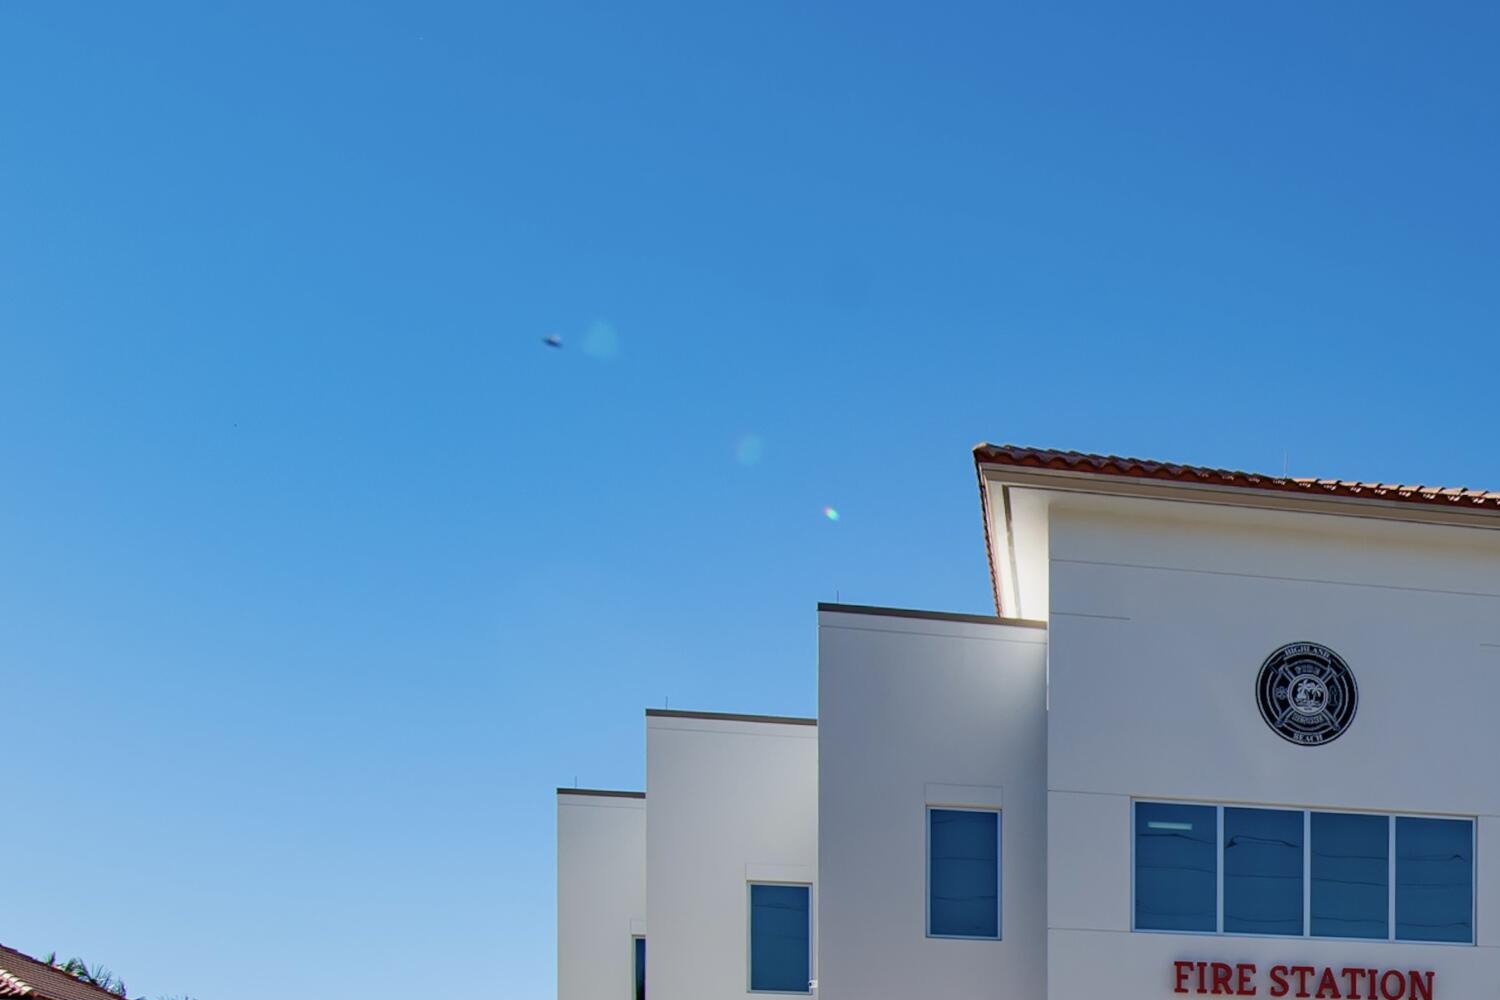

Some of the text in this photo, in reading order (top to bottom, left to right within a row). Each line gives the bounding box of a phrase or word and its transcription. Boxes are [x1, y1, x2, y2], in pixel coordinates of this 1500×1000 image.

[1284, 645, 1331, 660] HIGHLAND
[1292, 732, 1324, 743] BEACH
[1173, 960, 1257, 996] FIRE
